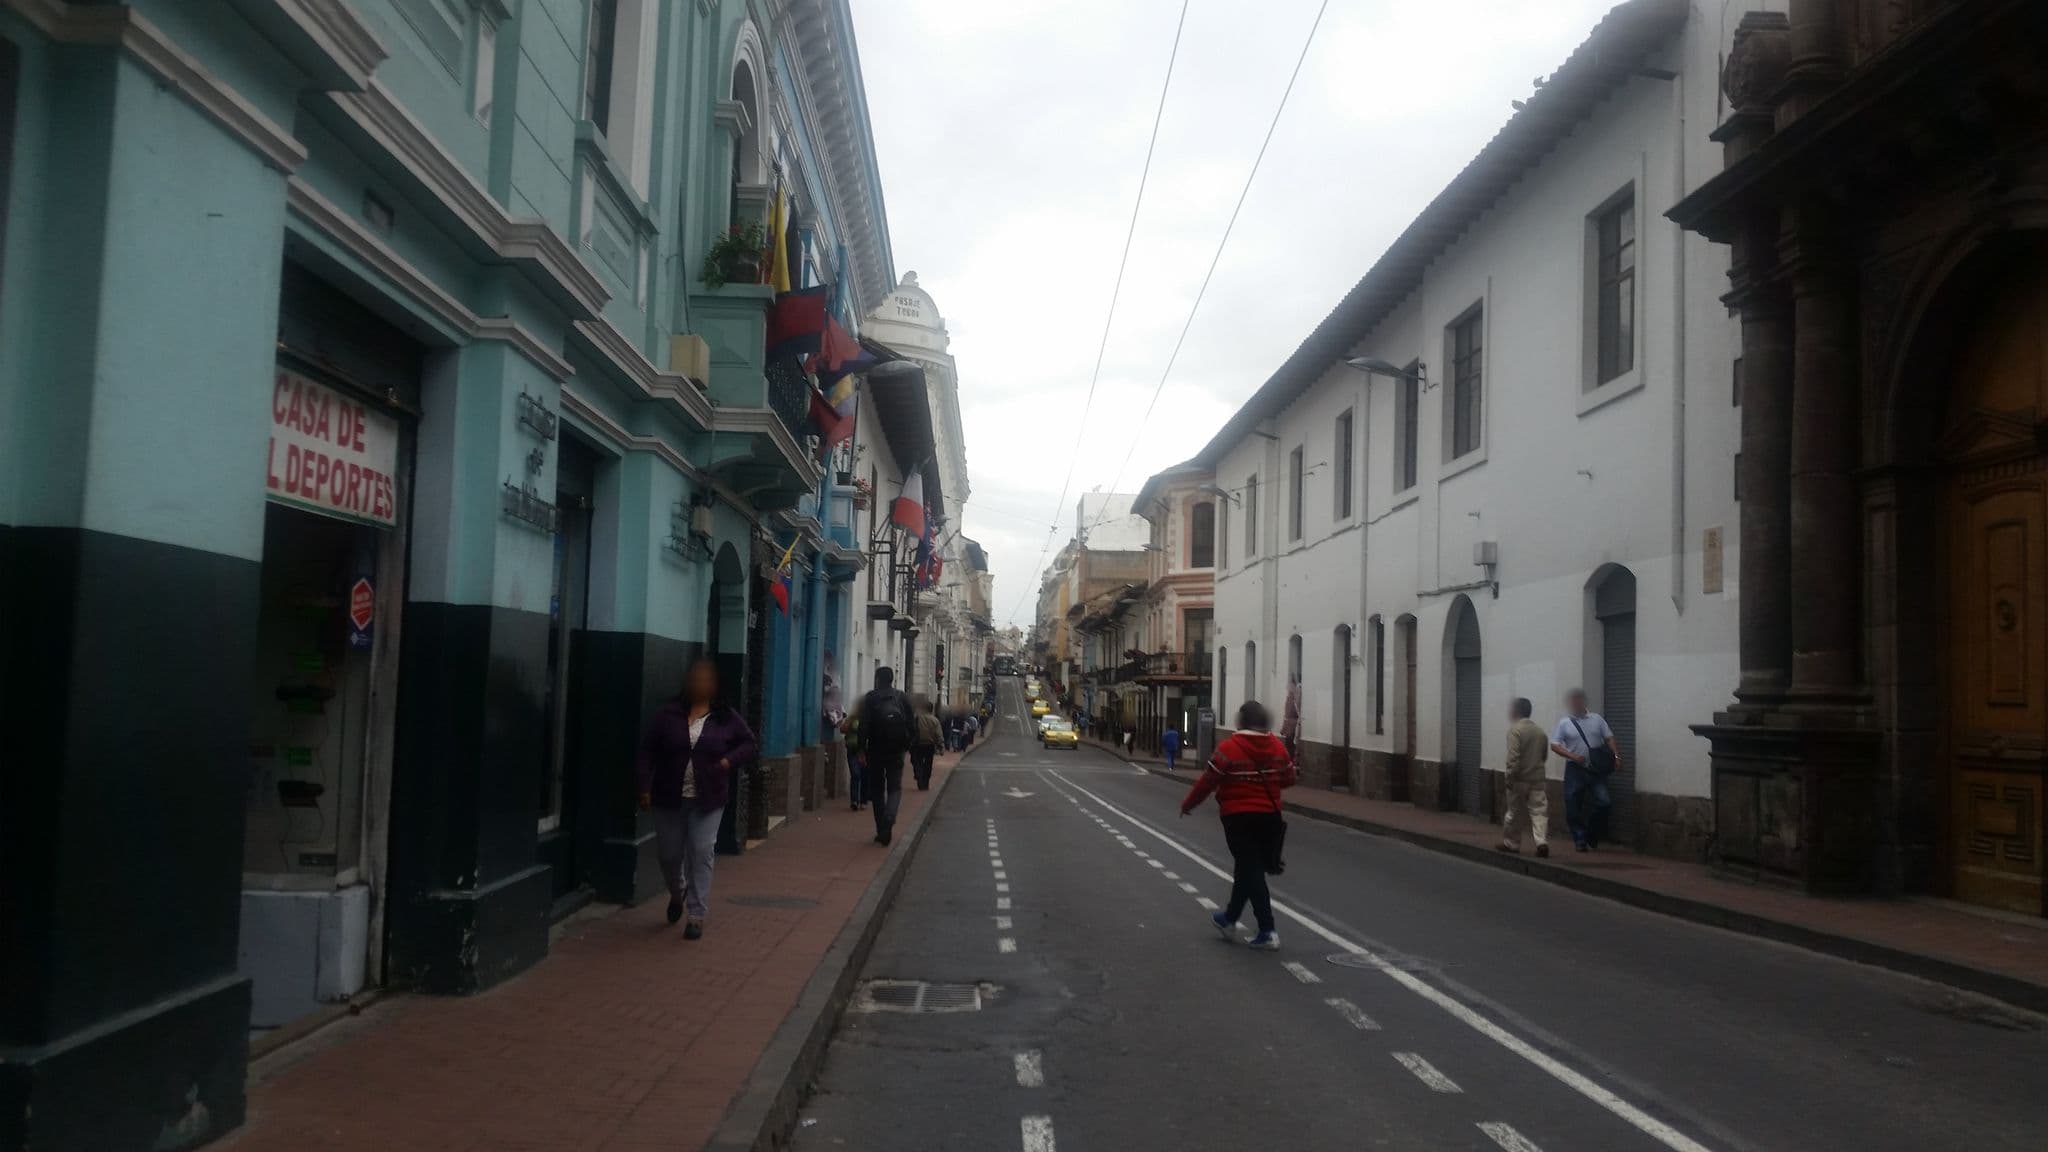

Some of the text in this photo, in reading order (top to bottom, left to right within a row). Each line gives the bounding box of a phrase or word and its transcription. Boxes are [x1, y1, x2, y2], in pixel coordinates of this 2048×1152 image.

[272, 374, 366, 453] CASA DE
[286, 444, 394, 520] DEPORTES
